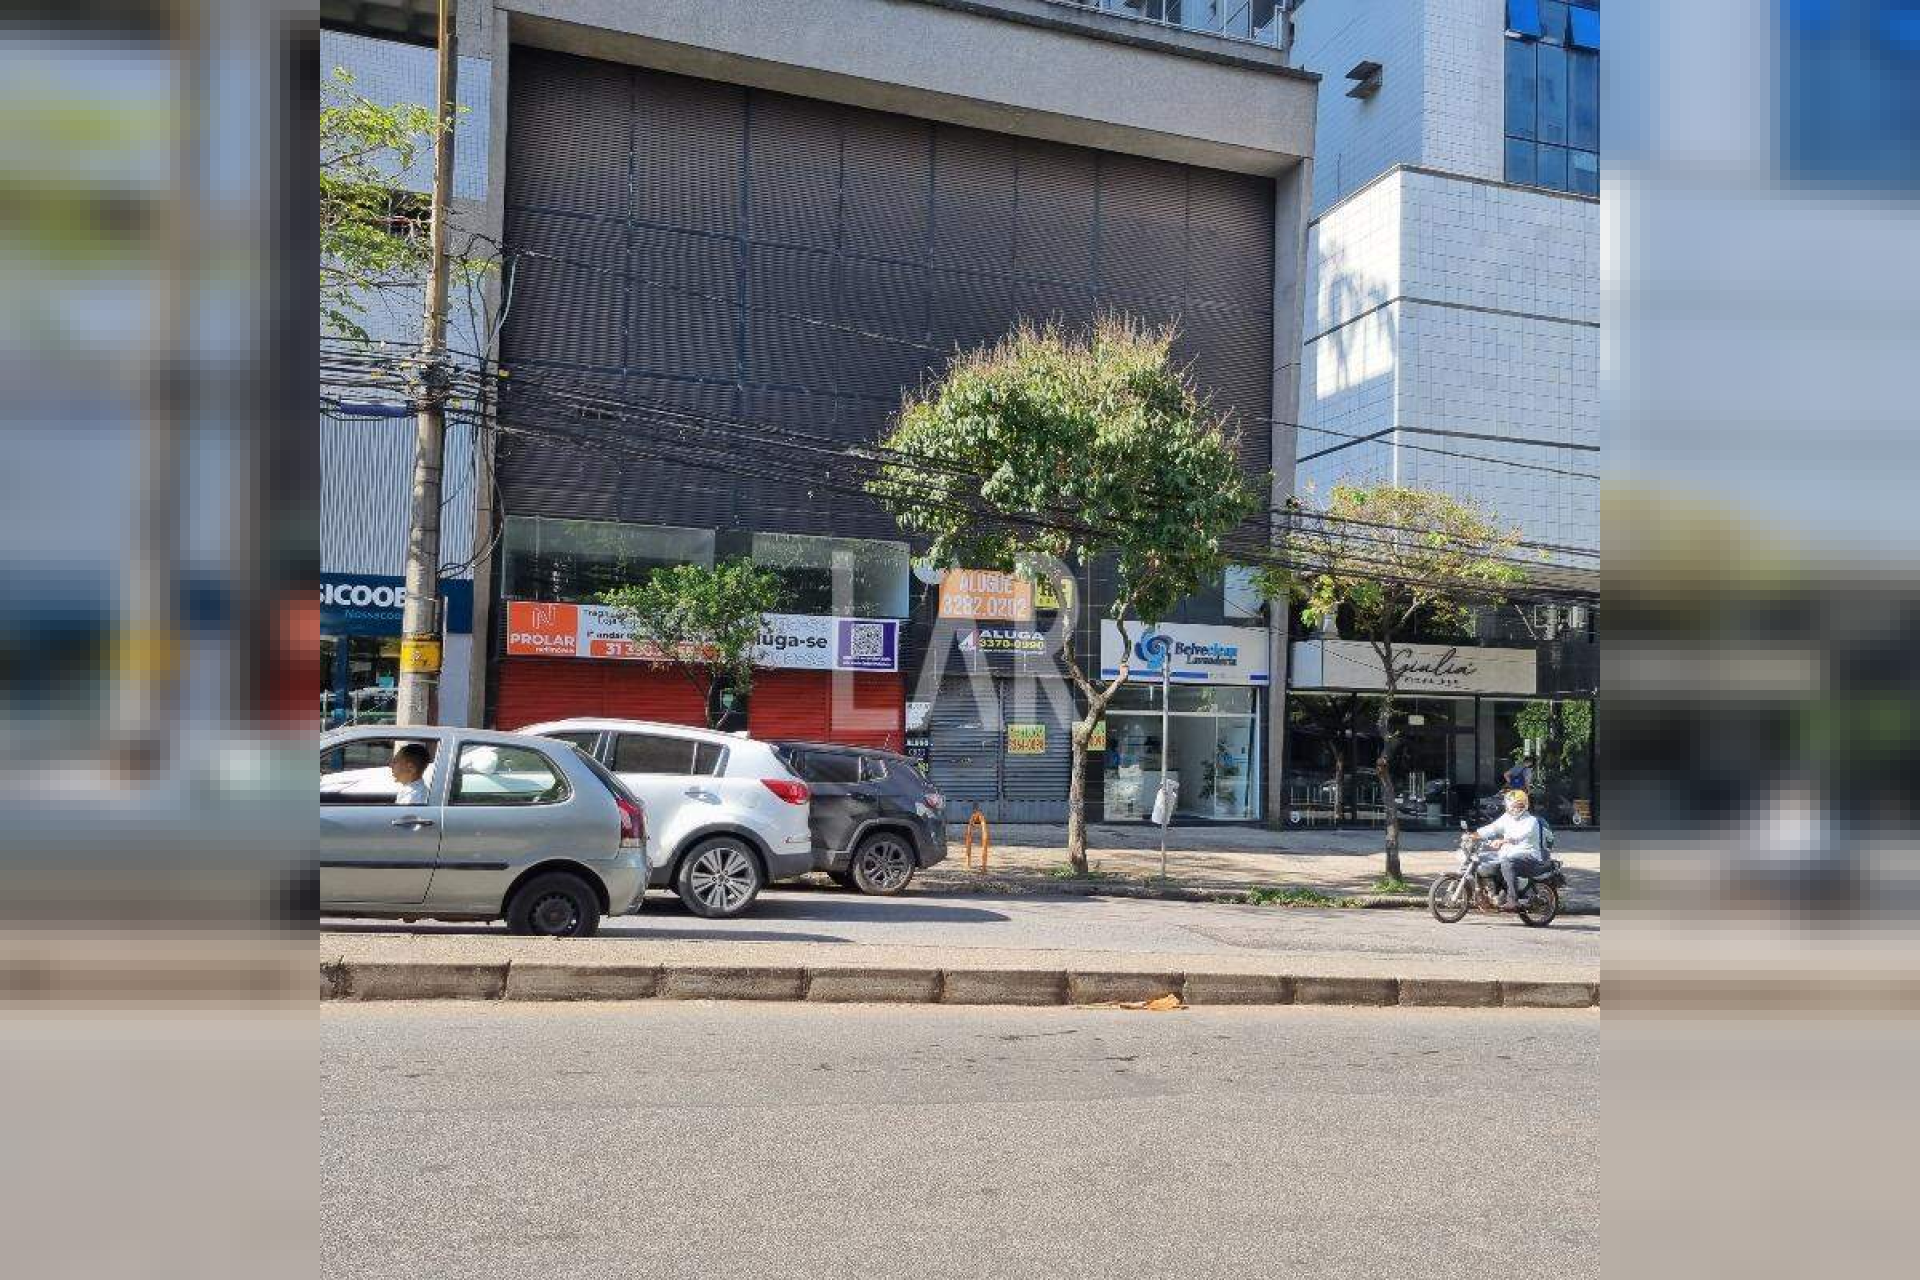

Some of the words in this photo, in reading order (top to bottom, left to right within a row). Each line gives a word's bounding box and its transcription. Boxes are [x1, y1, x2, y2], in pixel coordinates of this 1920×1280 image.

[510, 633, 576, 647] PROLAR
[756, 632, 828, 651] luga-se
[979, 629, 1045, 641] ALUGA
